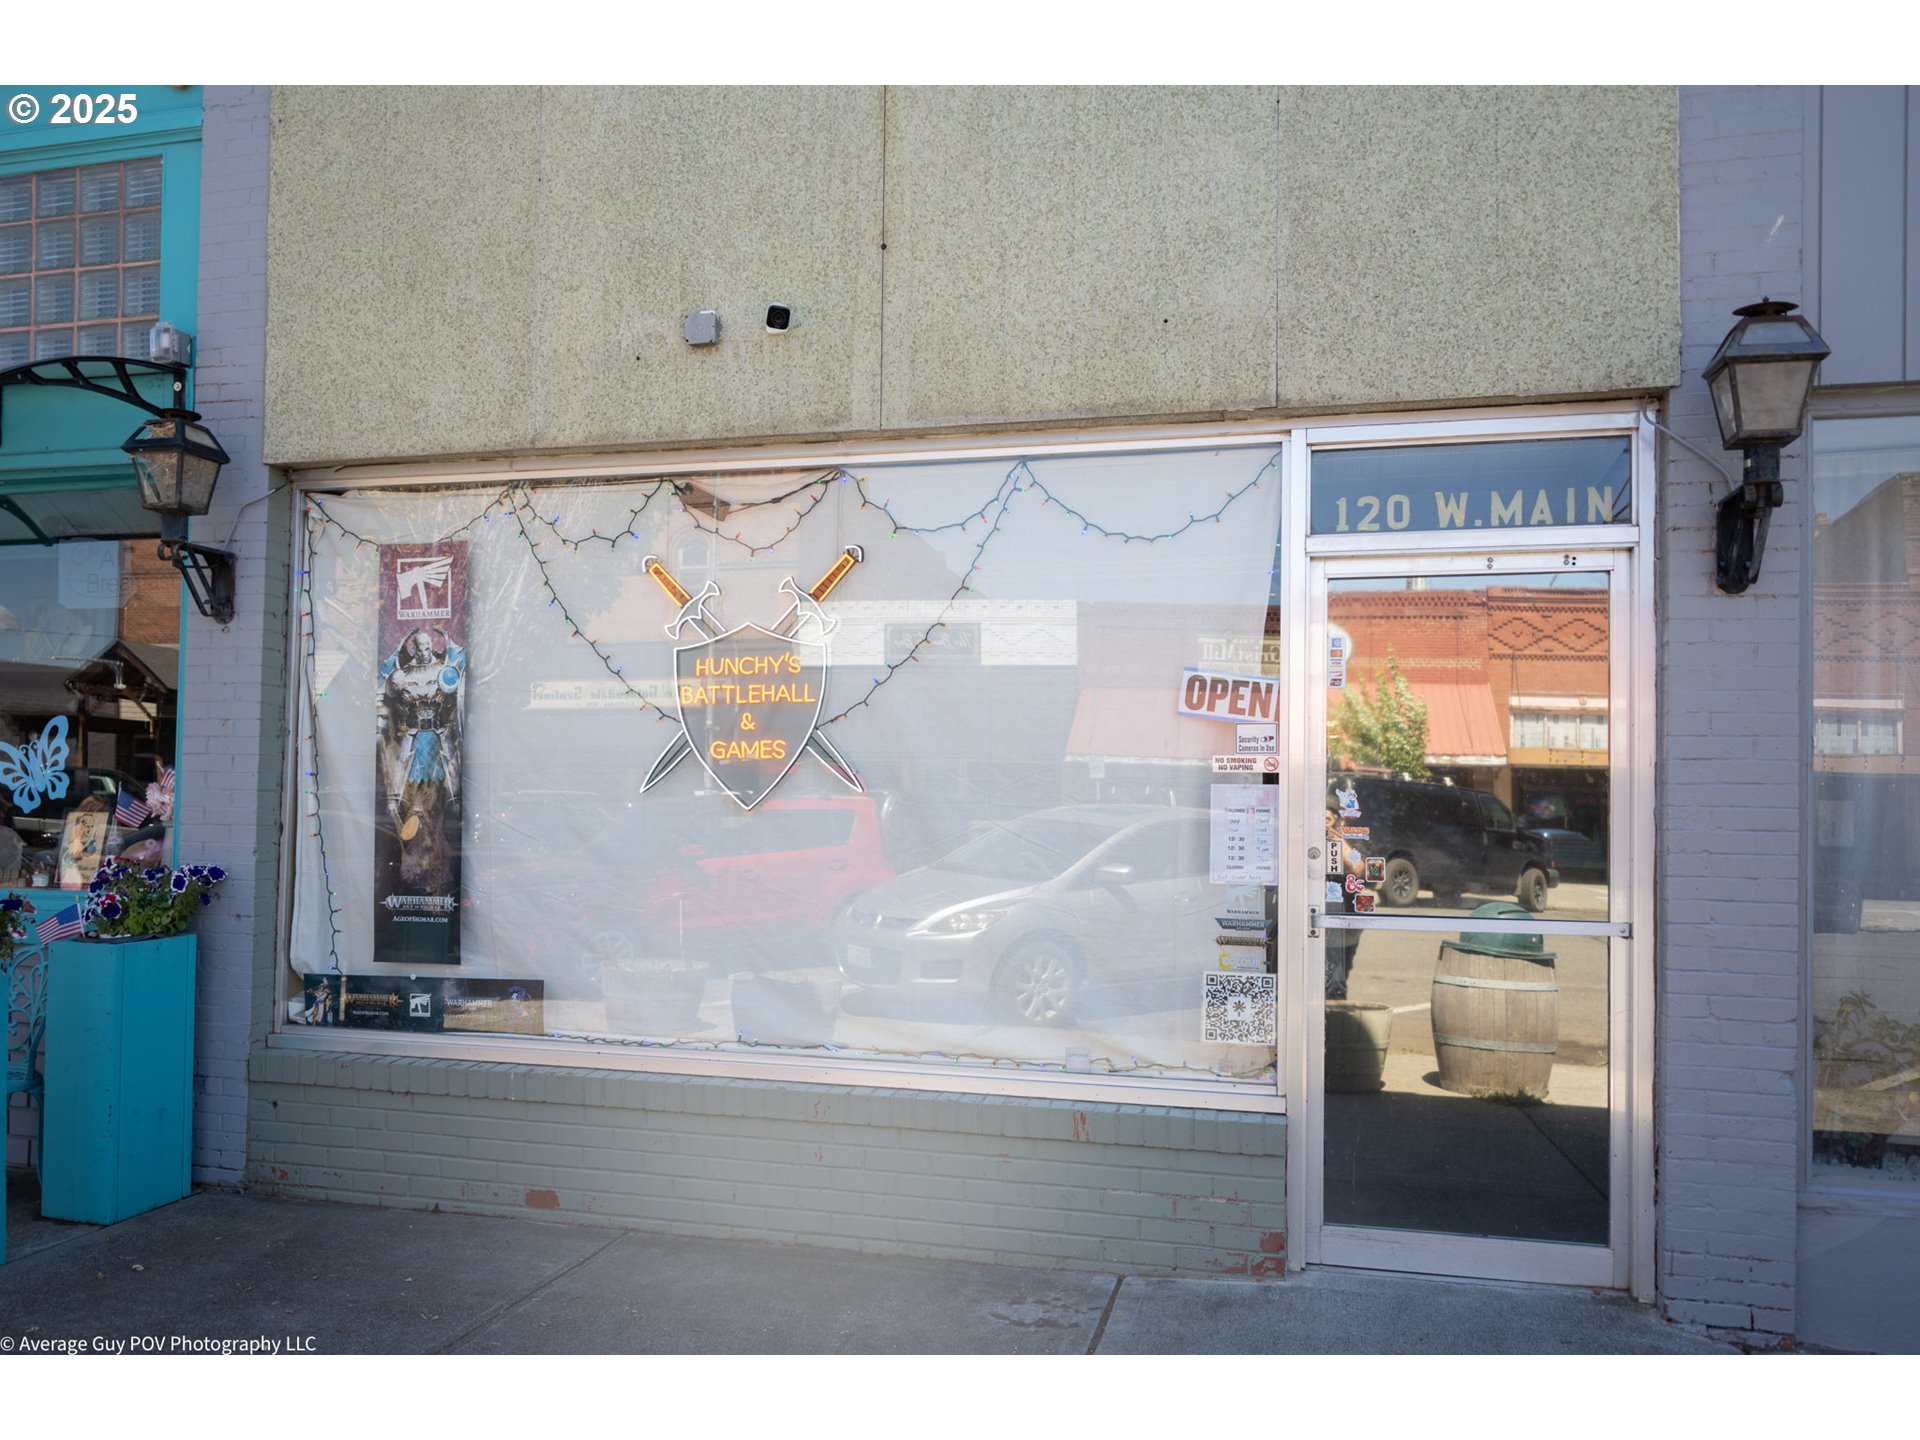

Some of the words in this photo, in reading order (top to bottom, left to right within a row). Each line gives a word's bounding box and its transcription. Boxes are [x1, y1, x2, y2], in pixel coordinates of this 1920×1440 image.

[1336, 494, 1411, 532] 120
[399, 610, 450, 618] WARHAMMER
[695, 652, 802, 676] HUNCHY'S
[681, 683, 816, 704] BATTLEHALL
[1184, 674, 1274, 719] OPEN
[740, 712, 756, 730] &
[1238, 736, 1260, 744] Security
[710, 740, 786, 759] GAMES
[386, 895, 454, 912] WARHAMMER
[392, 915, 449, 923] AGEOFSIGMAR.COM
[1221, 920, 1265, 928] WARHAMMER
